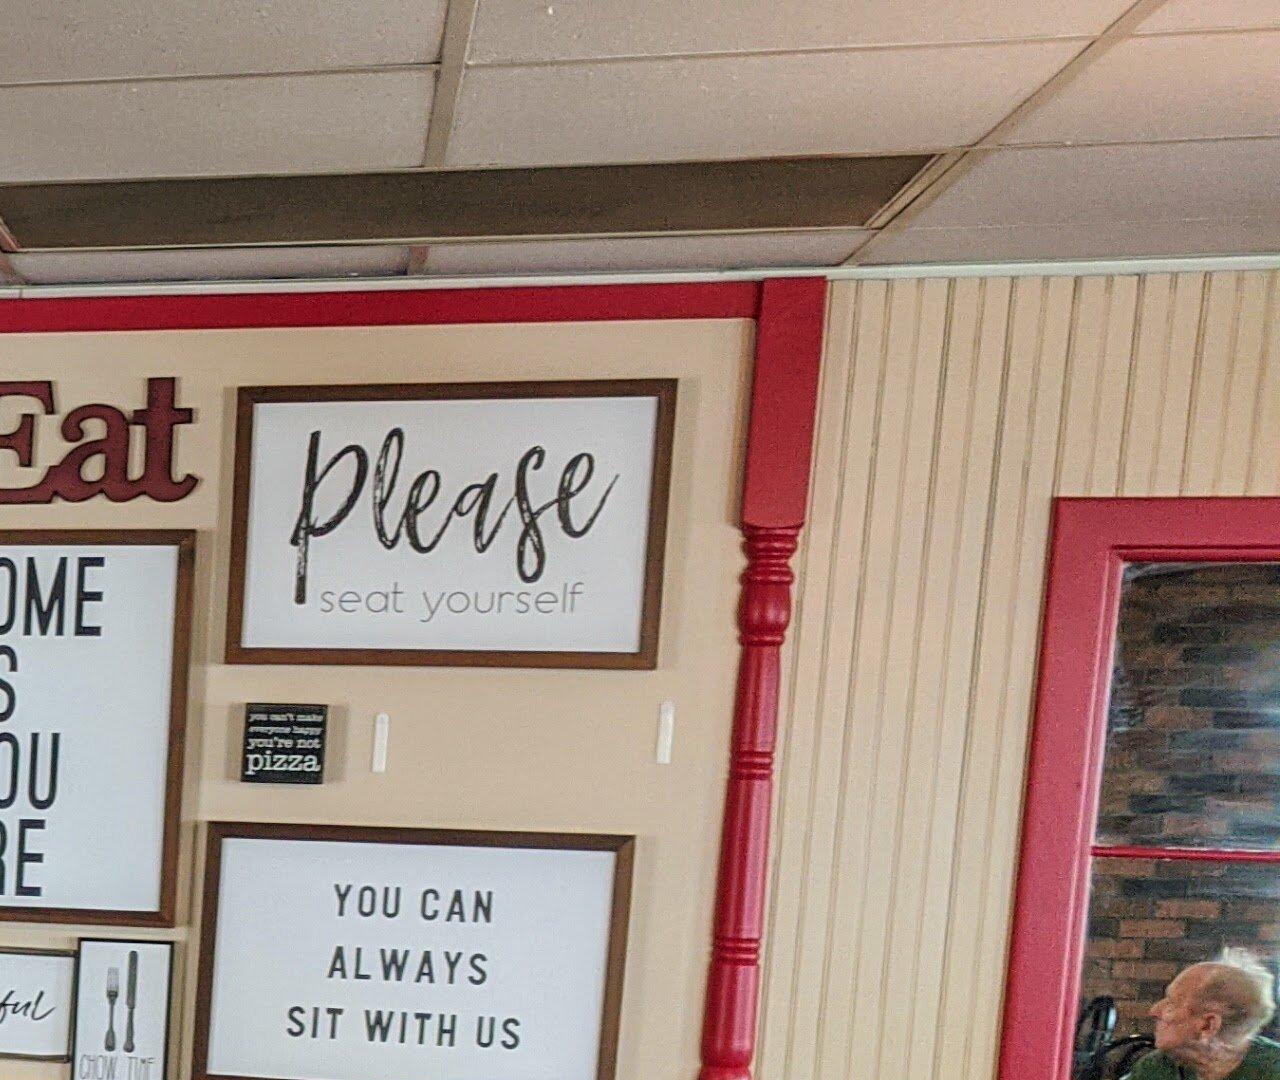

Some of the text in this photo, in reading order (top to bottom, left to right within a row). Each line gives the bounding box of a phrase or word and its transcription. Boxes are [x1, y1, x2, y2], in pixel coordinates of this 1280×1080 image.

[290, 427, 620, 605] please
[320, 581, 585, 623] seat yourself
[246, 736, 294, 750] you're
[334, 884, 493, 923] YOU CAN
[327, 945, 488, 985] ALWAYS
[286, 1005, 521, 1051] SIT WITH US
